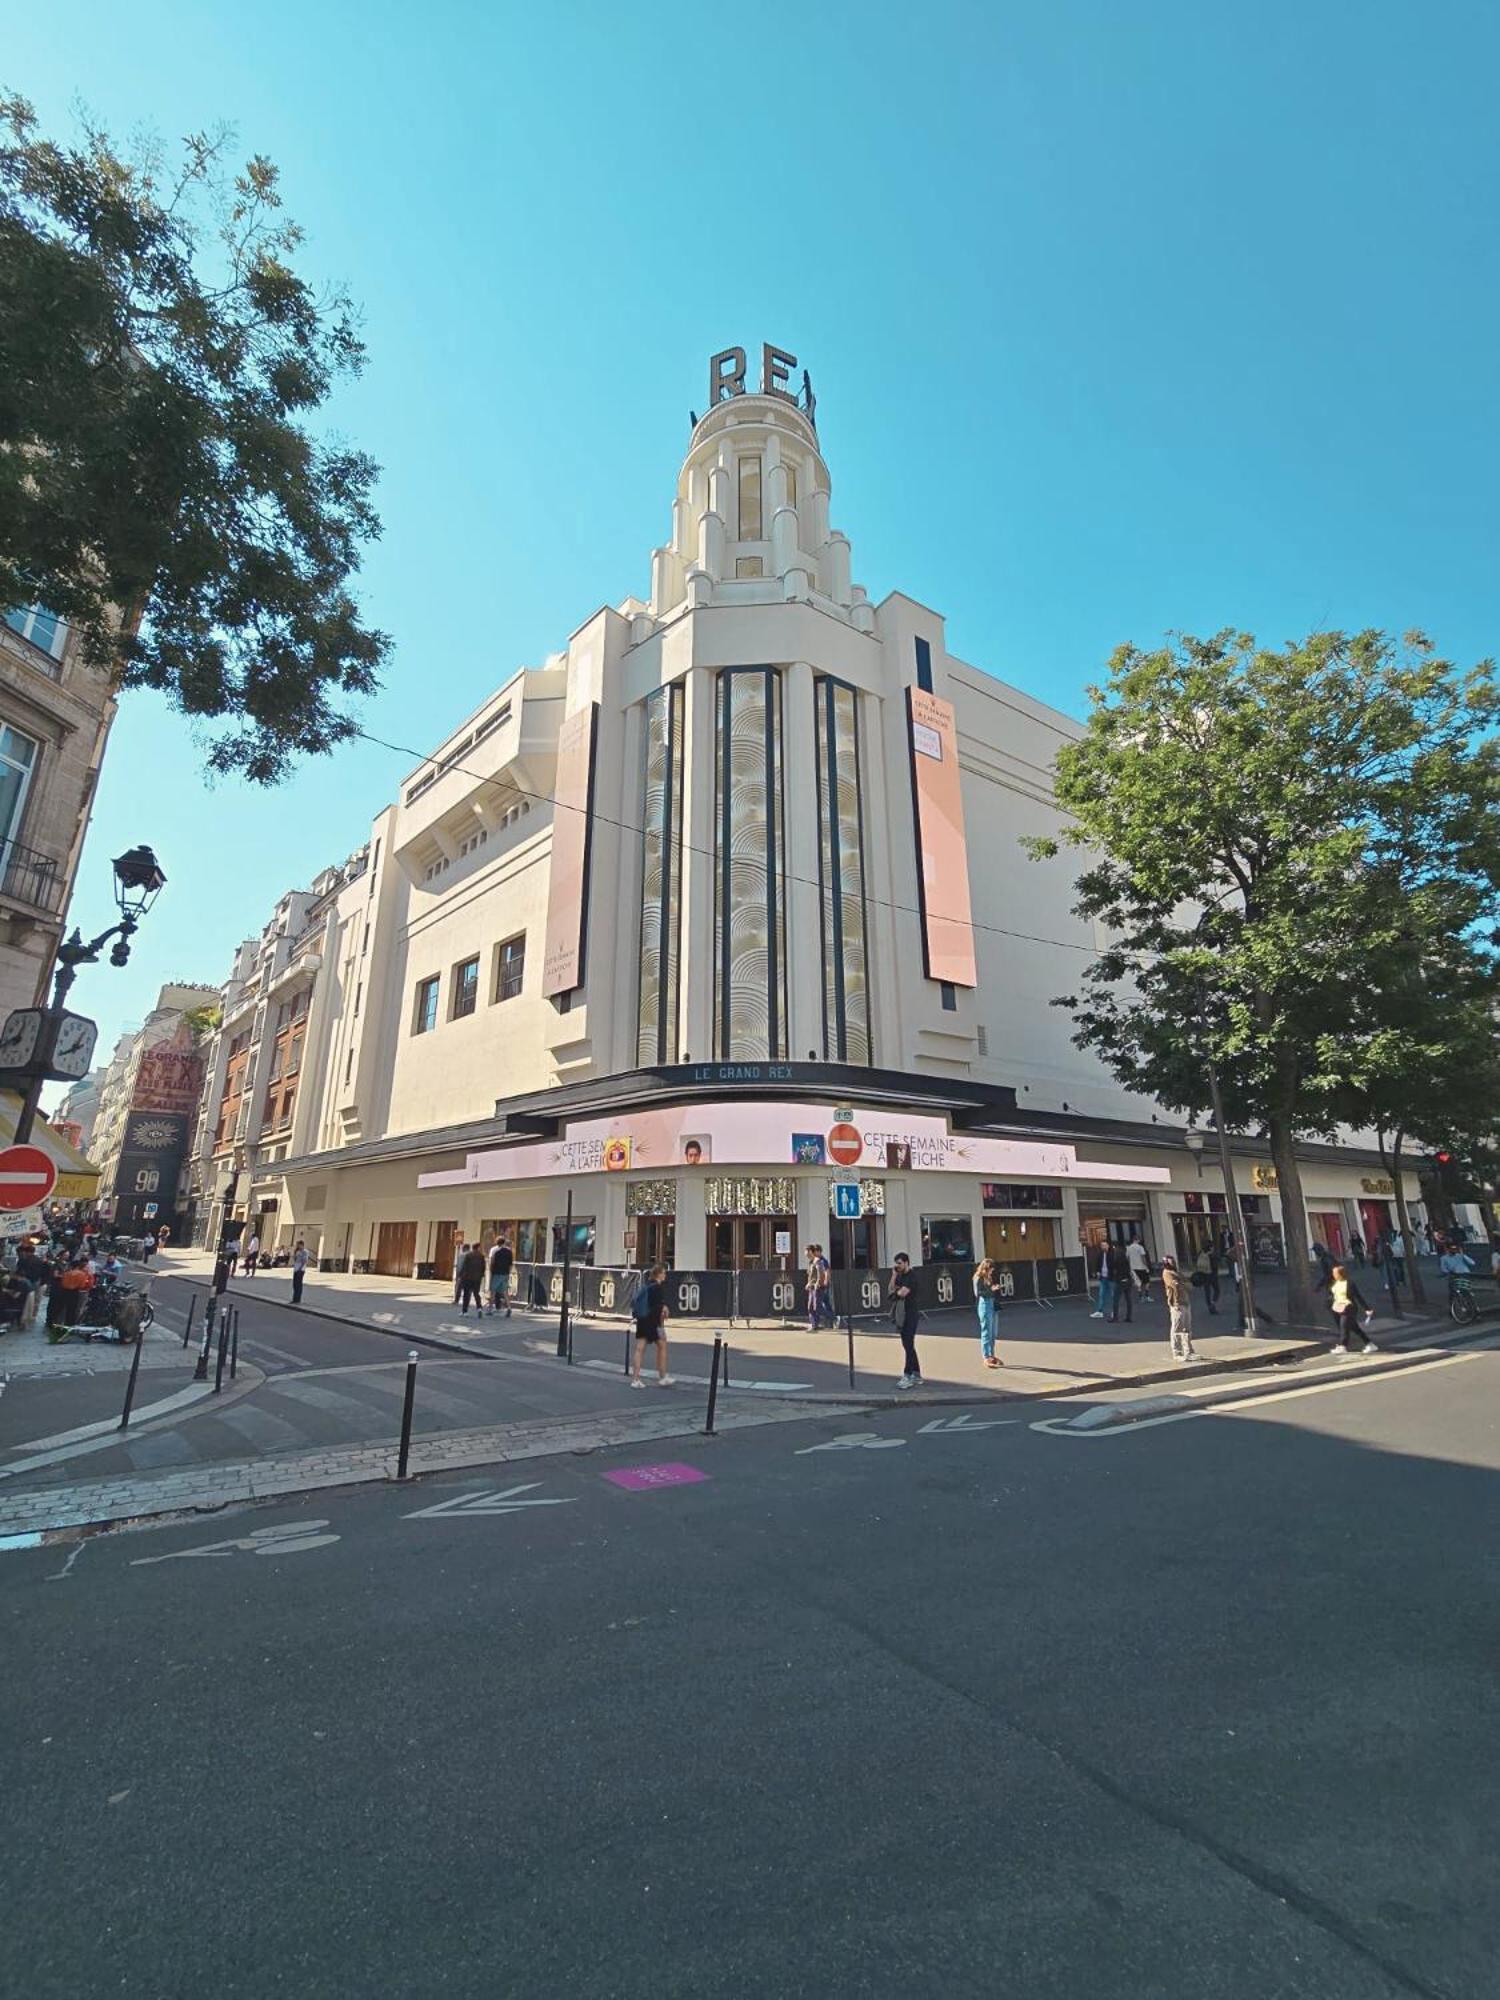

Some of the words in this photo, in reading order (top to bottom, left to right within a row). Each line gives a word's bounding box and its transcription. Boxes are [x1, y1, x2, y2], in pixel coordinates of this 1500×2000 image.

[710, 341, 815, 417] RE
[695, 1067, 711, 1080] LE
[719, 1066, 760, 1079] GRAND
[768, 1066, 793, 1079] REX
[562, 1141, 587, 1157] CETTE
[862, 1132, 898, 1147] CETTE
[903, 1136, 956, 1152] SEMAINE
[912, 1152, 945, 1167] FICHE
[135, 1170, 160, 1192] 90
[937, 1278, 953, 1302] 90
[1056, 1268, 1069, 1291] 90
[599, 1281, 615, 1308] 90
[678, 1284, 700, 1311] 90
[773, 1283, 795, 1310] 90
[862, 1282, 881, 1308] 90
